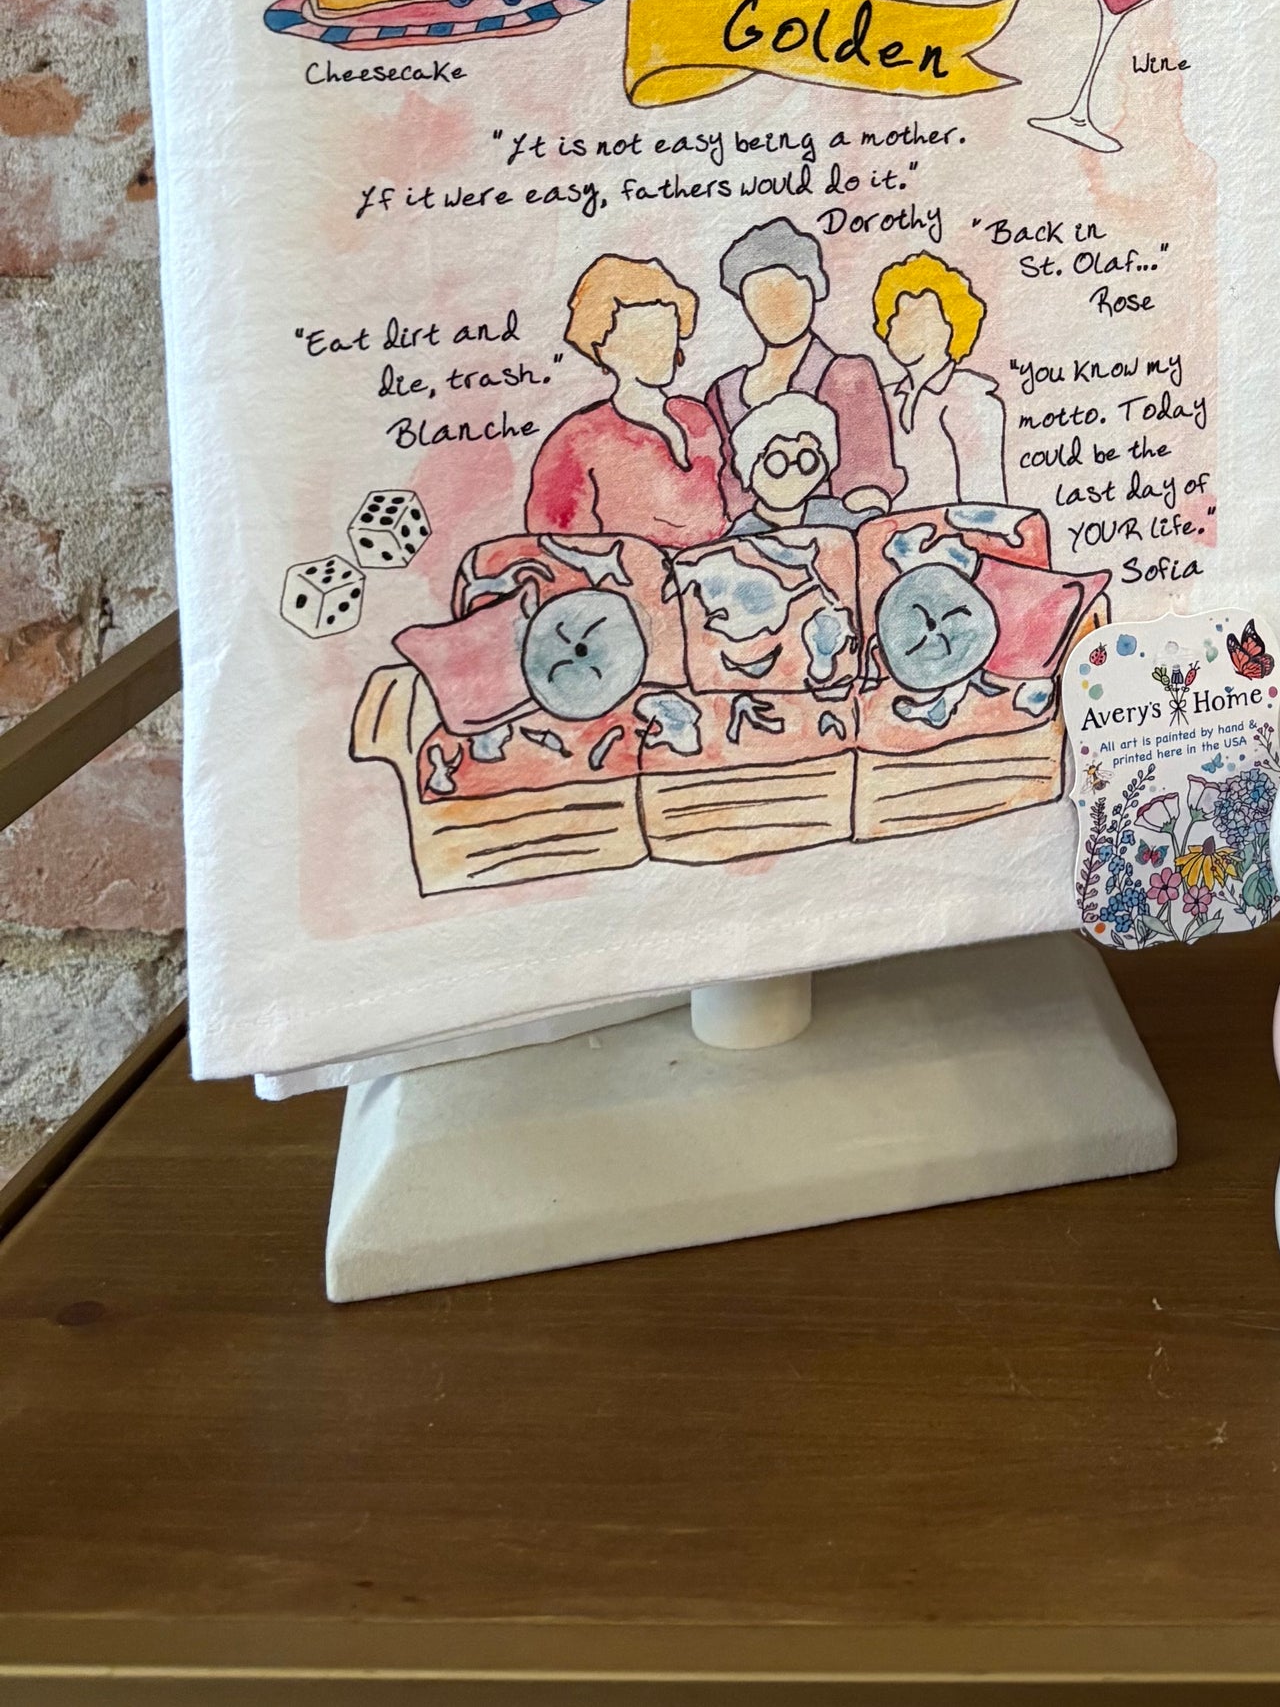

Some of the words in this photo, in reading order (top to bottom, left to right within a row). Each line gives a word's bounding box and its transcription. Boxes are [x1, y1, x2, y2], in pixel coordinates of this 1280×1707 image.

[305, 60, 468, 85] Cheesecake
[1132, 52, 1192, 74] Wine
[492, 129, 546, 166] "It
[558, 130, 587, 158] is
[596, 133, 643, 157] not
[654, 131, 724, 167] easy
[734, 126, 815, 162] being
[828, 131, 852, 149] a
[860, 120, 966, 147] mother.
[355, 185, 396, 220] If
[405, 186, 435, 210] it
[444, 186, 514, 208] were
[525, 182, 608, 218] easy,
[620, 173, 732, 201] fathers
[740, 163, 813, 196] would
[824, 162, 860, 195] do
[870, 160, 919, 190] it."
[816, 205, 943, 245] Dorothy
[971, 217, 1064, 245] "Back
[1075, 222, 1107, 243] in
[1019, 255, 1063, 279] St.
[1088, 285, 1156, 318] Rose
[294, 327, 370, 357] "Eat
[382, 316, 440, 351] dirt
[452, 308, 521, 344] and
[377, 363, 436, 399] die,
[445, 352, 564, 390] trash."
[1073, 357, 1139, 383] know
[1146, 354, 1183, 387] my
[1018, 405, 1106, 430] motto.
[1117, 390, 1207, 430] Today
[386, 410, 541, 450] Blanche
[1019, 435, 1084, 469] could
[1093, 443, 1121, 465] be
[1127, 435, 1172, 460] the
[1055, 480, 1116, 507] last
[1126, 470, 1176, 510] day
[1183, 472, 1211, 495] of
[1150, 503, 1217, 539] life."
[1121, 556, 1204, 584] Sofia
[1080, 701, 1162, 732] Avery's
[1193, 686, 1263, 714] Home
[1099, 741, 1115, 753] All
[1120, 737, 1138, 750] art
[1142, 736, 1152, 747] is
[1155, 729, 1196, 747] painted
[1200, 727, 1214, 739] by
[1217, 720, 1245, 735] hand
[1248, 720, 1258, 729] &
[1112, 750, 1154, 769] printed
[1156, 747, 1183, 759] here
[1186, 745, 1197, 755] in
[1201, 741, 1220, 752] the
[1223, 735, 1248, 749] USA
